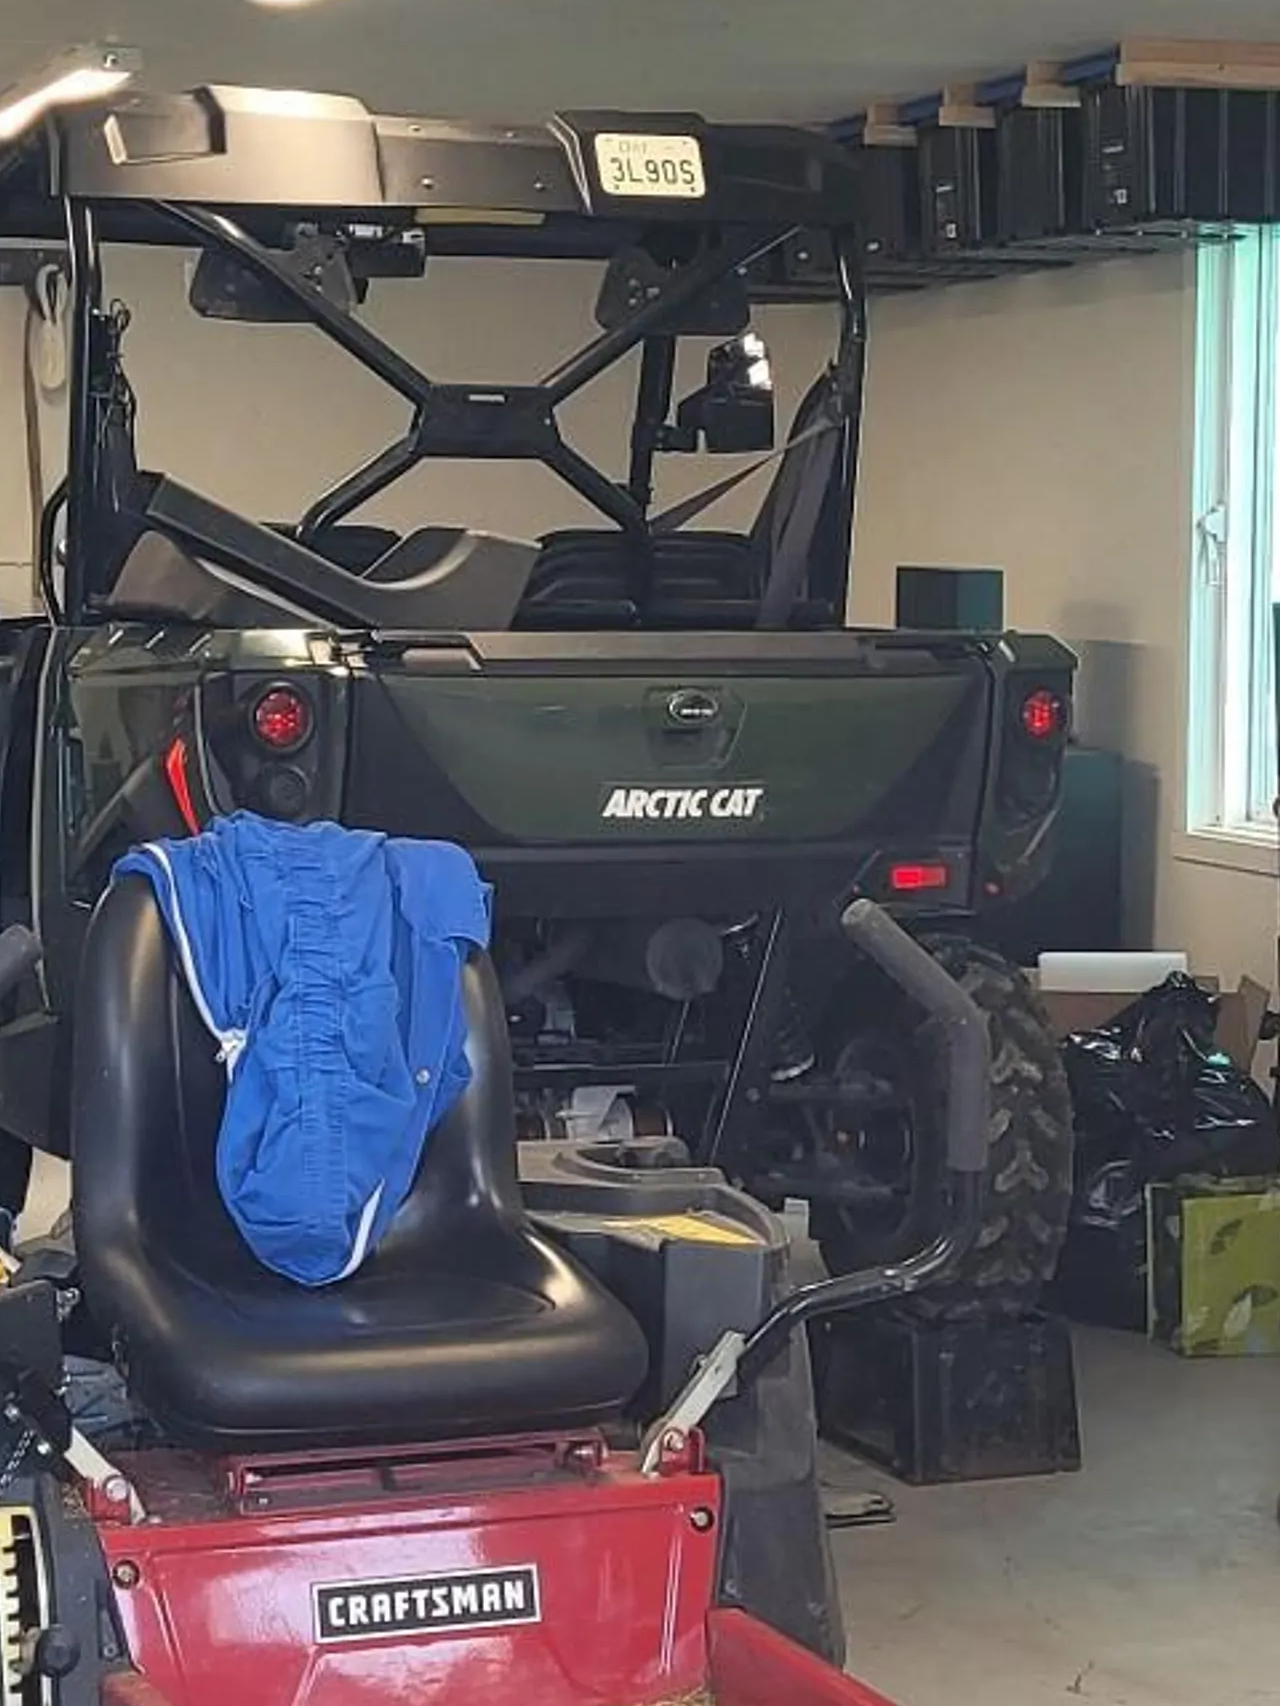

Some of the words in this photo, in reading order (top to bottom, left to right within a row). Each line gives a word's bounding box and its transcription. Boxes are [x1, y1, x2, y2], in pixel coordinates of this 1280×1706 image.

[602, 789, 708, 818] ARCTIC
[709, 789, 764, 817] CAT
[327, 1579, 525, 1627] CRAFTSMAN
